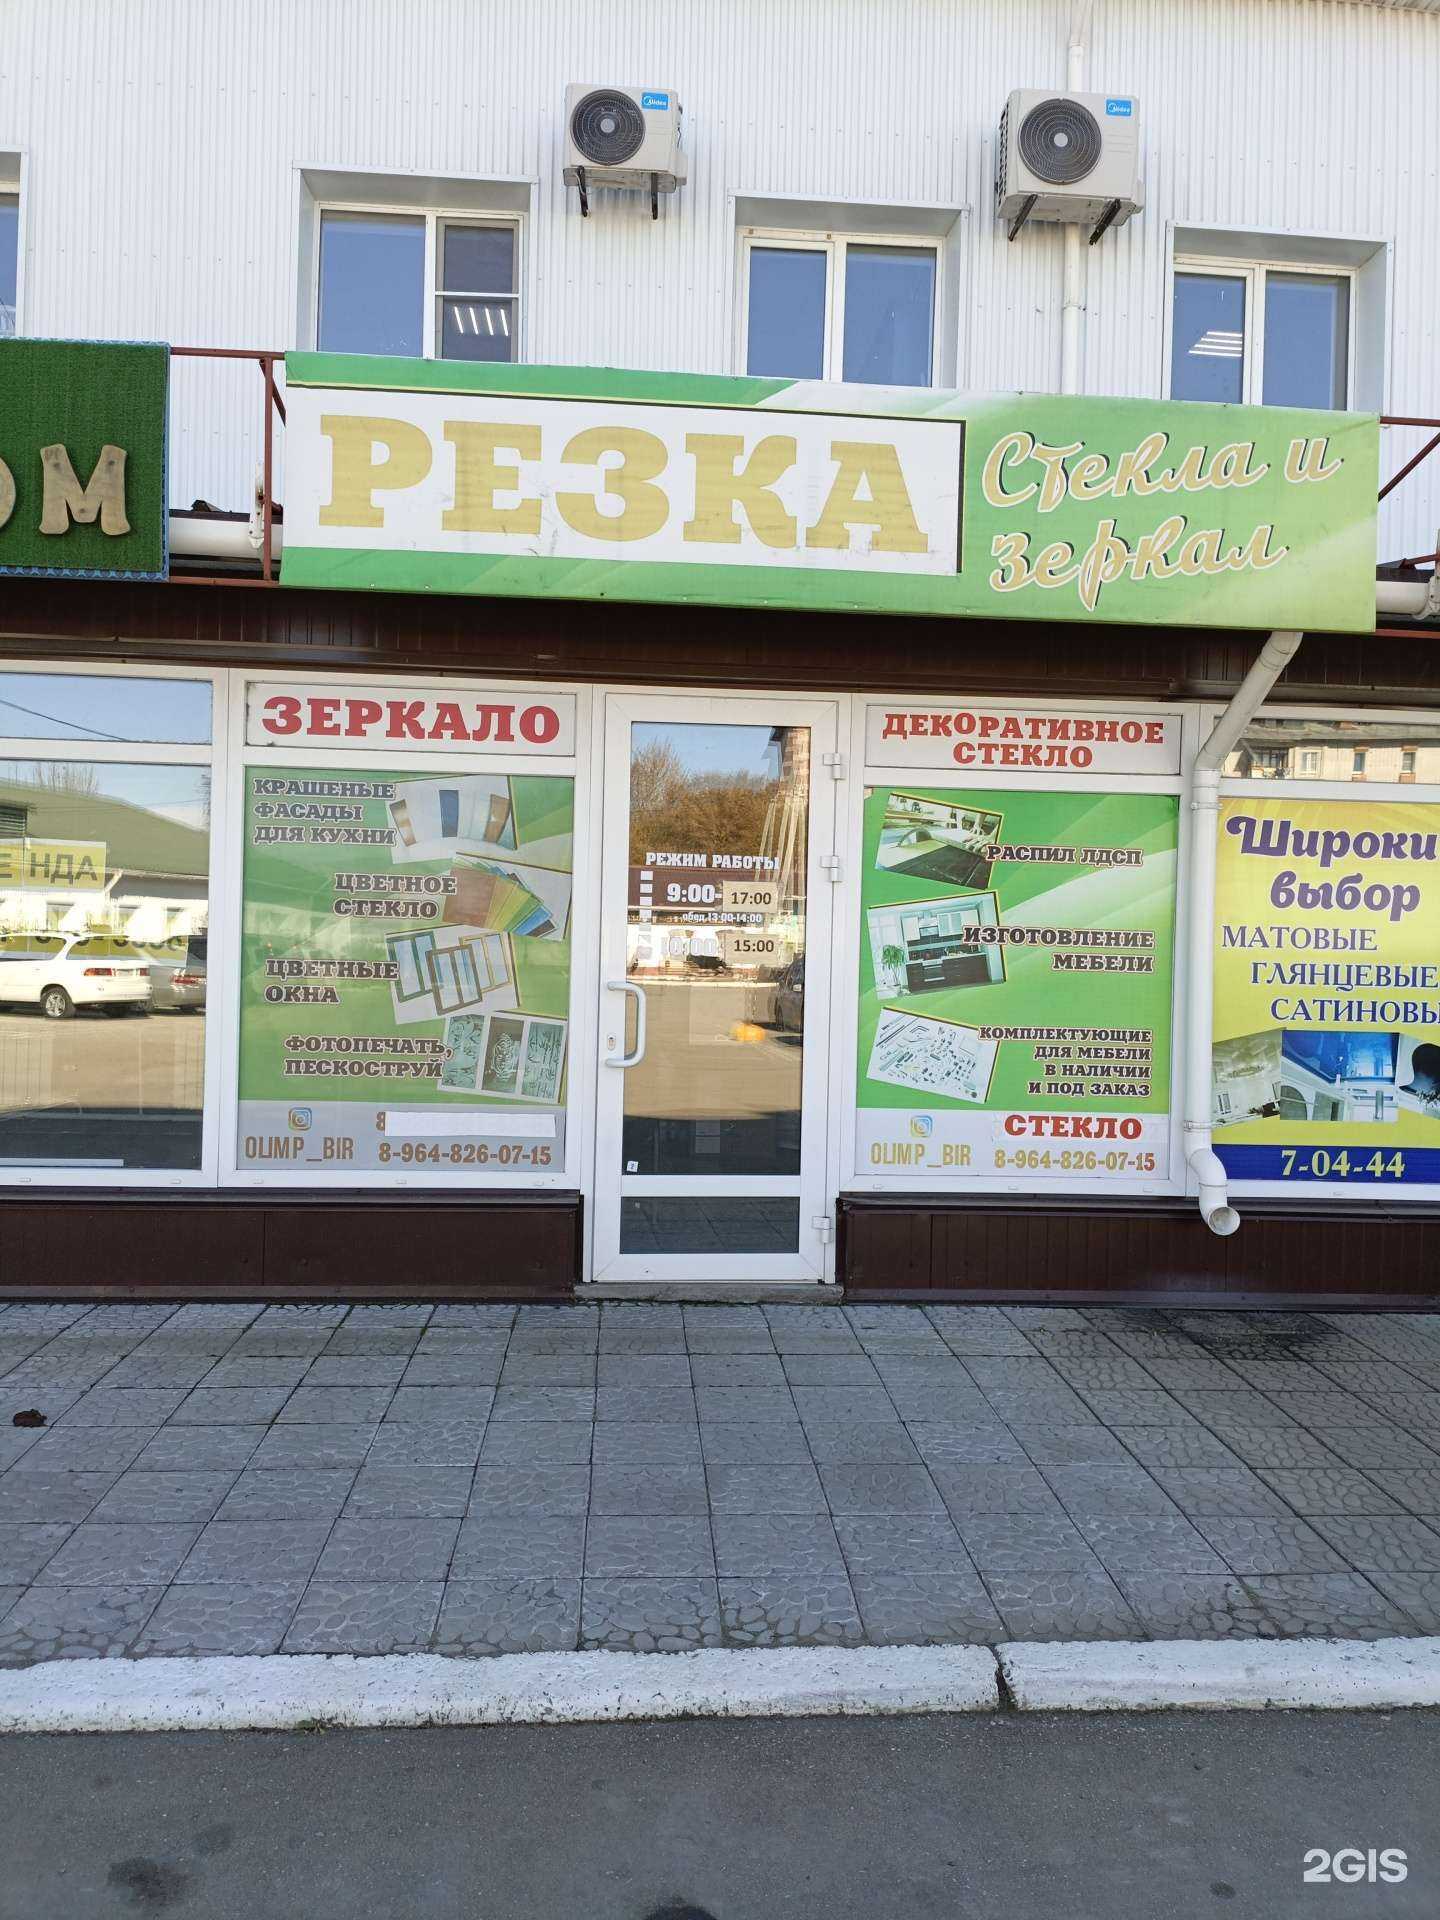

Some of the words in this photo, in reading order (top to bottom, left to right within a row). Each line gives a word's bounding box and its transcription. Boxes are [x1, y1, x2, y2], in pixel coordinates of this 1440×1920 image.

[982, 431, 1271, 513] Стекла
[1284, 434, 1345, 484] и
[0, 444, 131, 536] М
[319, 414, 928, 554] РЕЗКА
[262, 696, 560, 744] ЗЕРКАЛО
[882, 712, 1164, 744] ДЕКОРАТИВНОЕ
[953, 741, 1093, 767] СТЕКЛО
[254, 778, 396, 800] КРАШЕНЫЕ
[253, 803, 363, 822] ФАСАДЫ
[253, 826, 305, 846] ДЛЯ
[310, 827, 397, 846] КУХНИ
[1226, 815, 1438, 868] Широки
[645, 852, 707, 868] РЕЖИМ
[712, 854, 781, 870] РАБОТЫ
[987, 846, 1076, 864] РАСПИЛ
[1080, 848, 1144, 867] ЛДСП
[335, 873, 457, 896] ЦВЕТНОЕ
[731, 891, 772, 905] 17:00
[1270, 870, 1421, 922] выбор
[333, 898, 439, 919] СТЕКЛО
[733, 939, 775, 953] 15:00
[963, 927, 1154, 948] ИЗГОТОВЛЕНИЕ
[1222, 925, 1378, 951] МАТОВЫЕ
[265, 959, 399, 981] ЦВЕТНЫЕ
[1053, 954, 1154, 972] МЕБЕЛИ
[1251, 962, 1438, 992] ГЛЯНЦЕВЫЕ
[265, 985, 340, 1004] ОКНА
[979, 1025, 1153, 1044] КОМПЛЕКТУЮЩИЕ
[284, 1036, 453, 1058] ФОТОПЕЧАТЬ,
[1034, 1046, 1073, 1061] ДЛЯ
[1077, 1047, 1152, 1062] МЕБЕЛИ
[284, 1059, 444, 1079] ПЕСКОСТРУЙ
[1044, 1064, 1057, 1077] В
[1061, 1064, 1152, 1079] НАЛИЧИИ
[1028, 1082, 1041, 1095] И
[1047, 1082, 1085, 1097] ПОД
[1089, 1083, 1151, 1097] ЗАКАЗ
[1004, 1114, 1142, 1141] СТЕКЛО
[378, 1142, 552, 1165] 8-964-826-07-15
[994, 1149, 1155, 1172] 8-964-826-07-15
[1281, 1149, 1405, 1178] 7-04-44
